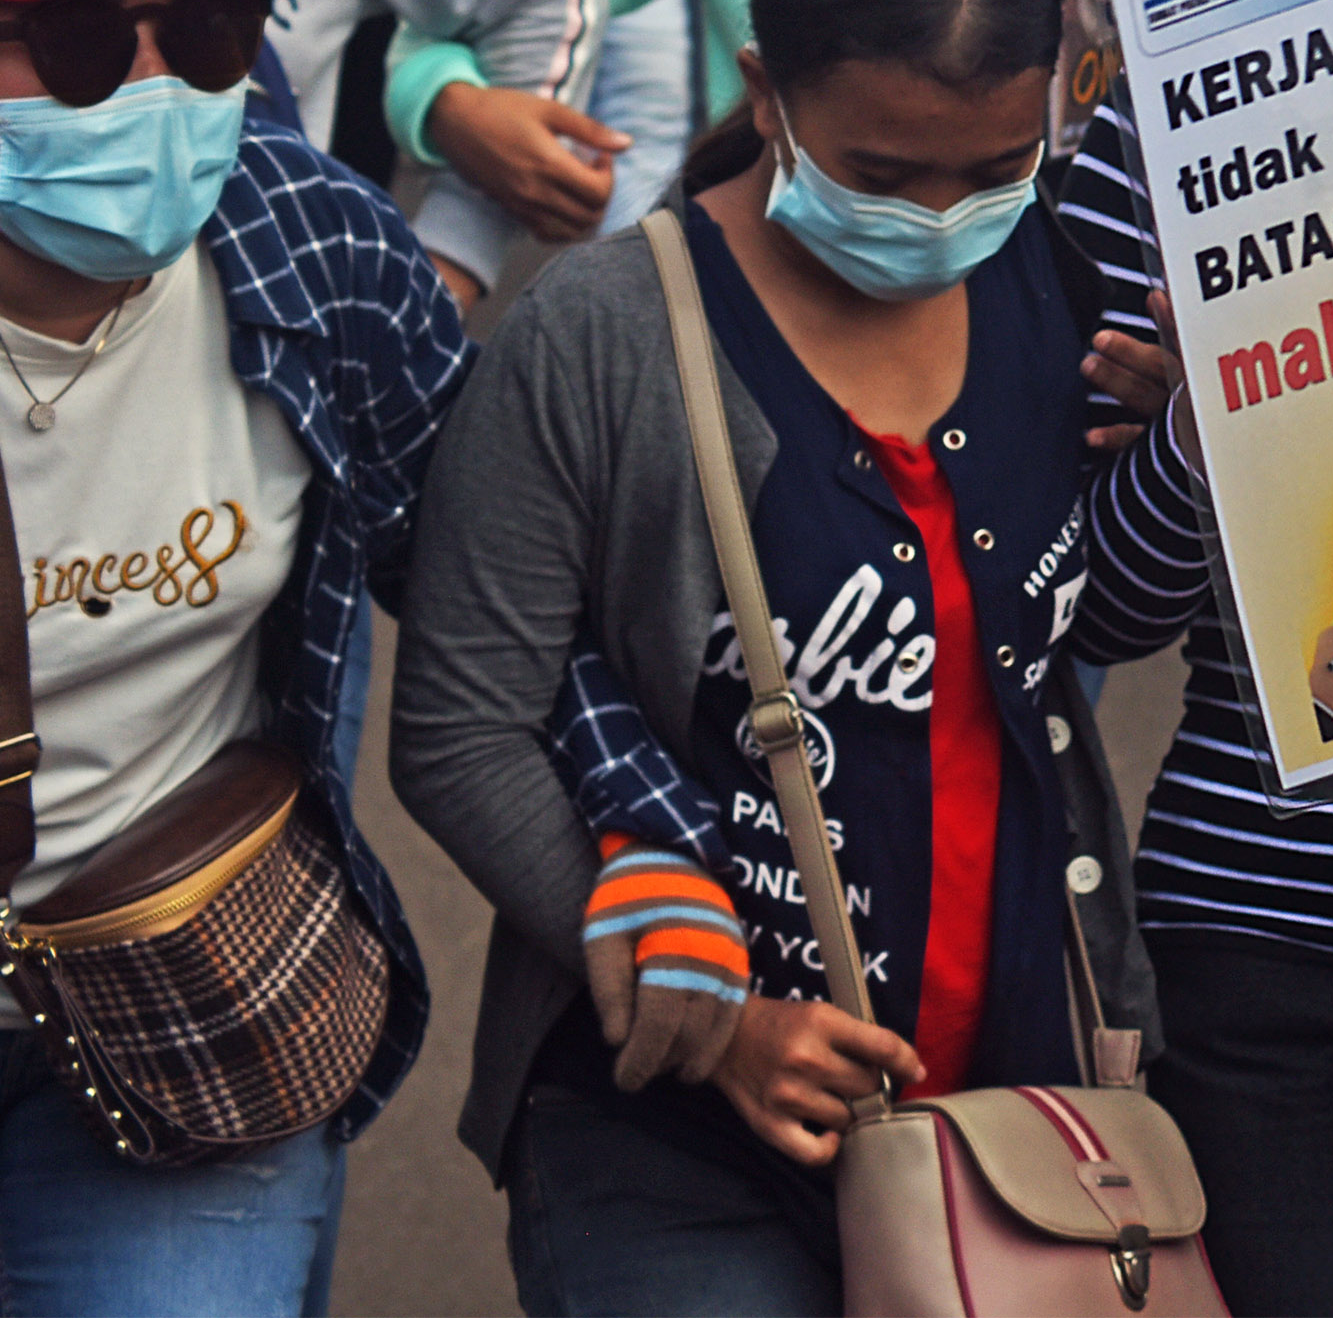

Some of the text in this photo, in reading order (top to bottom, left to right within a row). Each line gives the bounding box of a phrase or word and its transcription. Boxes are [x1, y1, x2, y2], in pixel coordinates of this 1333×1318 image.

[1178, 129, 1324, 215] tidak
[27, 500, 246, 614] incess
[733, 791, 844, 851] PAS
[774, 925, 889, 982] YOK
